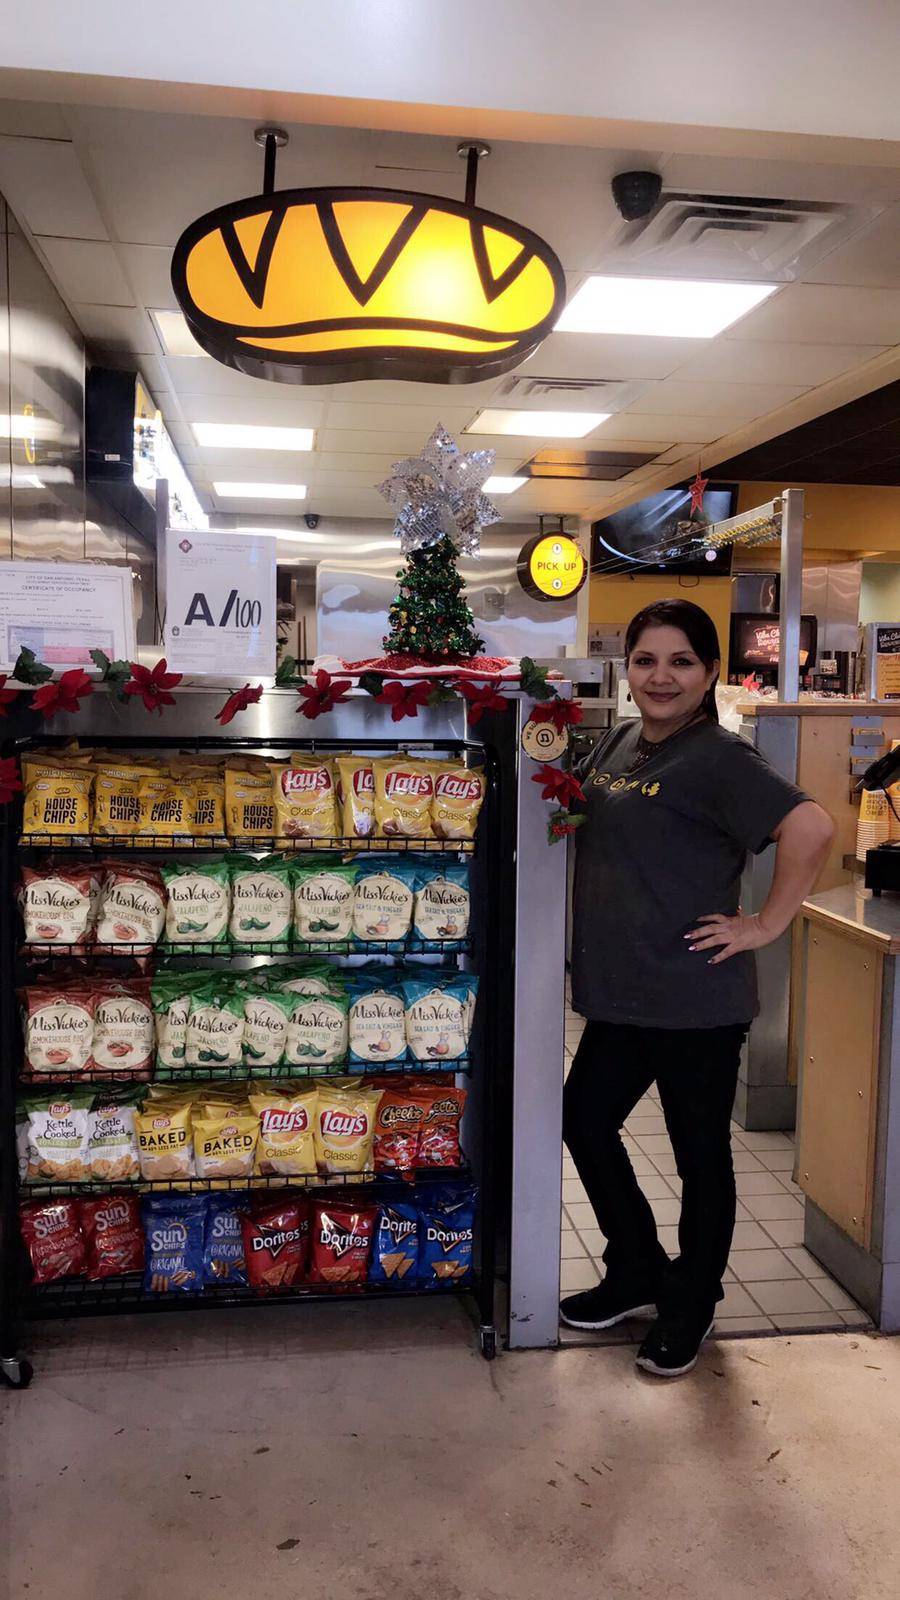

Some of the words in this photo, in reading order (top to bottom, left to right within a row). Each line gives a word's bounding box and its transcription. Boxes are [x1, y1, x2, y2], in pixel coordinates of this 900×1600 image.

[537, 562, 559, 571] PICK
[563, 562, 577, 571] UP
[284, 768, 327, 793] Lay's
[386, 773, 432, 797] Lay's
[436, 774, 480, 799] Lay's
[45, 797, 78, 811] HOUSE
[110, 795, 141, 809] HOUSE
[152, 799, 183, 812] HOUSE
[198, 799, 216, 811] USE
[43, 810, 76, 825] CHIPS
[109, 806, 141, 822] CHIPS
[150, 809, 182, 823] CHIPS
[192, 809, 215, 824] HIPS
[244, 805, 274, 817] HOUSE
[393, 807, 421, 818] Classi
[242, 816, 273, 830] CHIPS
[48, 890, 81, 909] Vickie's
[186, 883, 221, 903] Vickie's
[251, 882, 285, 902] Vickie's
[297, 886, 323, 902] Miss
[353, 886, 380, 900] Miss
[377, 885, 409, 905] Vickie's
[436, 890, 468, 906] Vickie's
[130, 892, 161, 916] Vickie's
[118, 1007, 150, 1029] Vickie's
[252, 1008, 284, 1031] Vickie's
[352, 1005, 377, 1019] Miss
[410, 1007, 434, 1021] Miss
[30, 1014, 56, 1031] Miss
[54, 1013, 89, 1034] Vickie's
[208, 1016, 238, 1034] Vickie's
[289, 1012, 314, 1028] Miss
[311, 1010, 343, 1033] Vickie's
[46, 1119, 73, 1131] Kettle
[95, 1118, 121, 1131] Kettle
[262, 1109, 307, 1133] Lay's
[322, 1112, 366, 1136] Lay's
[43, 1128, 77, 1140] Cooked
[93, 1126, 125, 1140] Cooked
[139, 1131, 186, 1147] BAKED
[204, 1135, 253, 1154] BAKED
[323, 1150, 359, 1161] Classic
[33, 1210, 69, 1239] Sun
[94, 1202, 130, 1232] Sun
[108, 1216, 131, 1228] CHIPS
[381, 1216, 417, 1234] Dorito
[48, 1221, 70, 1234] CHIPS
[224, 1229, 242, 1237] CHIP
[427, 1227, 473, 1242] Doritos
[151, 1228, 188, 1252] Sun
[163, 1242, 186, 1250] CHIPS
[252, 1228, 301, 1252] Doritos
[320, 1230, 369, 1248] Doritos
[150, 1256, 188, 1271] ORIGINAL
